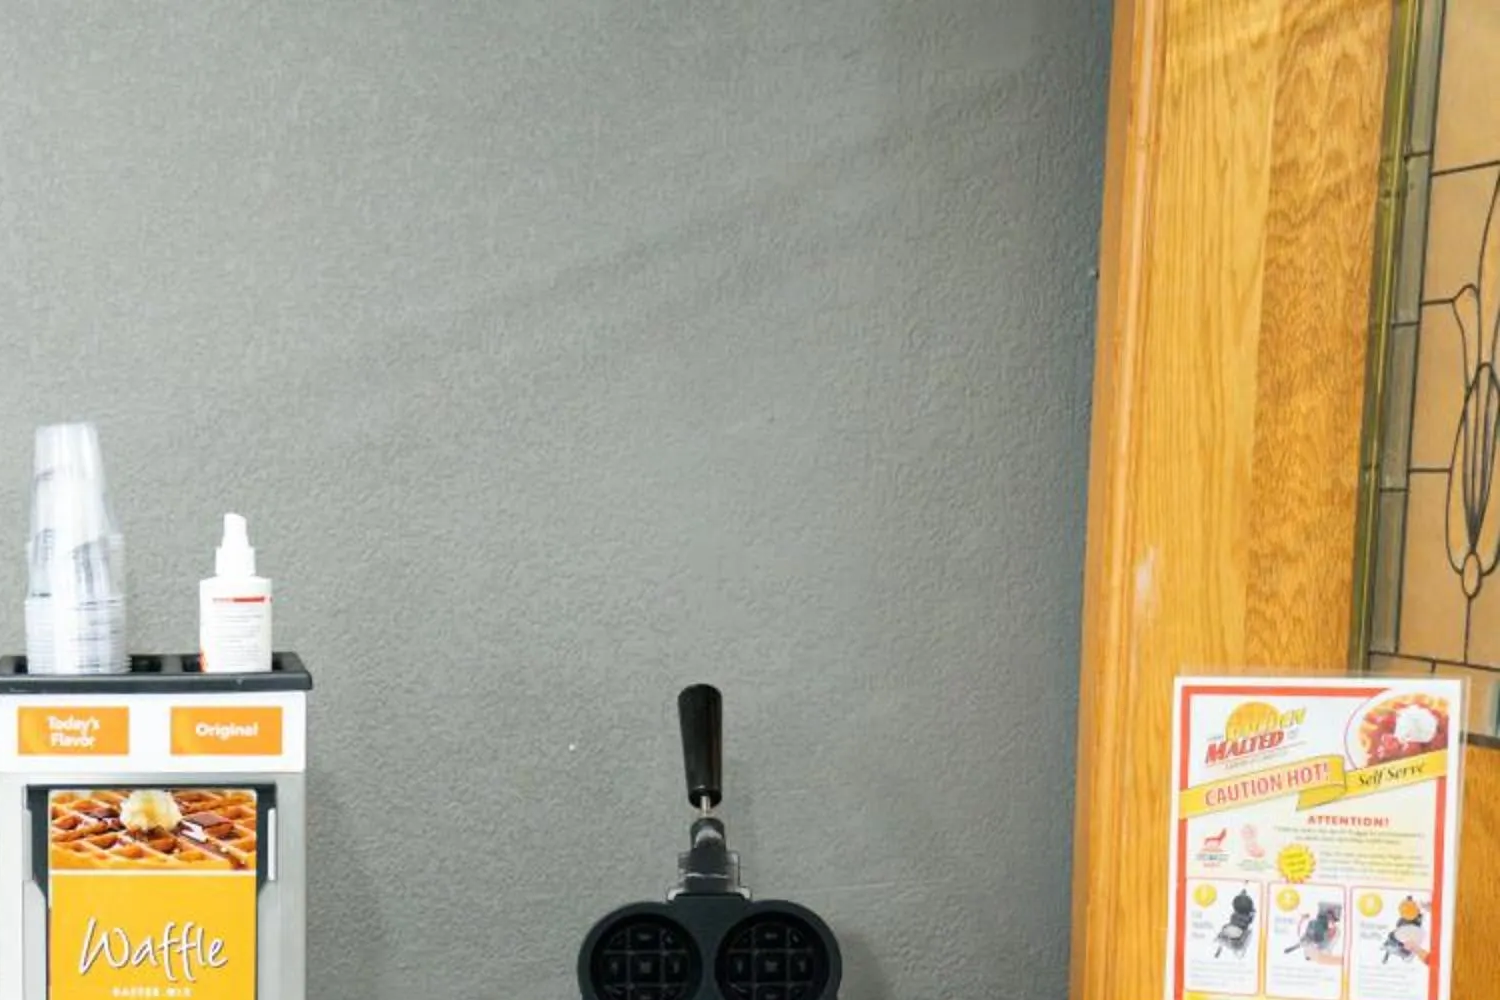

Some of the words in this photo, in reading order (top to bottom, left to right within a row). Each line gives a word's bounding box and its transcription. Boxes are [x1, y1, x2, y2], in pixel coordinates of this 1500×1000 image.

[47, 716, 100, 735] Today's
[195, 722, 259, 740] Original
[51, 732, 96, 747] Flavor
[1205, 730, 1284, 764] MALTED
[1205, 773, 1282, 806] CAUTION
[1287, 762, 1328, 788] HOT!
[1359, 769, 1383, 788] Self
[1307, 815, 1389, 828] ATTENTION!
[78, 916, 229, 983] Waffle
